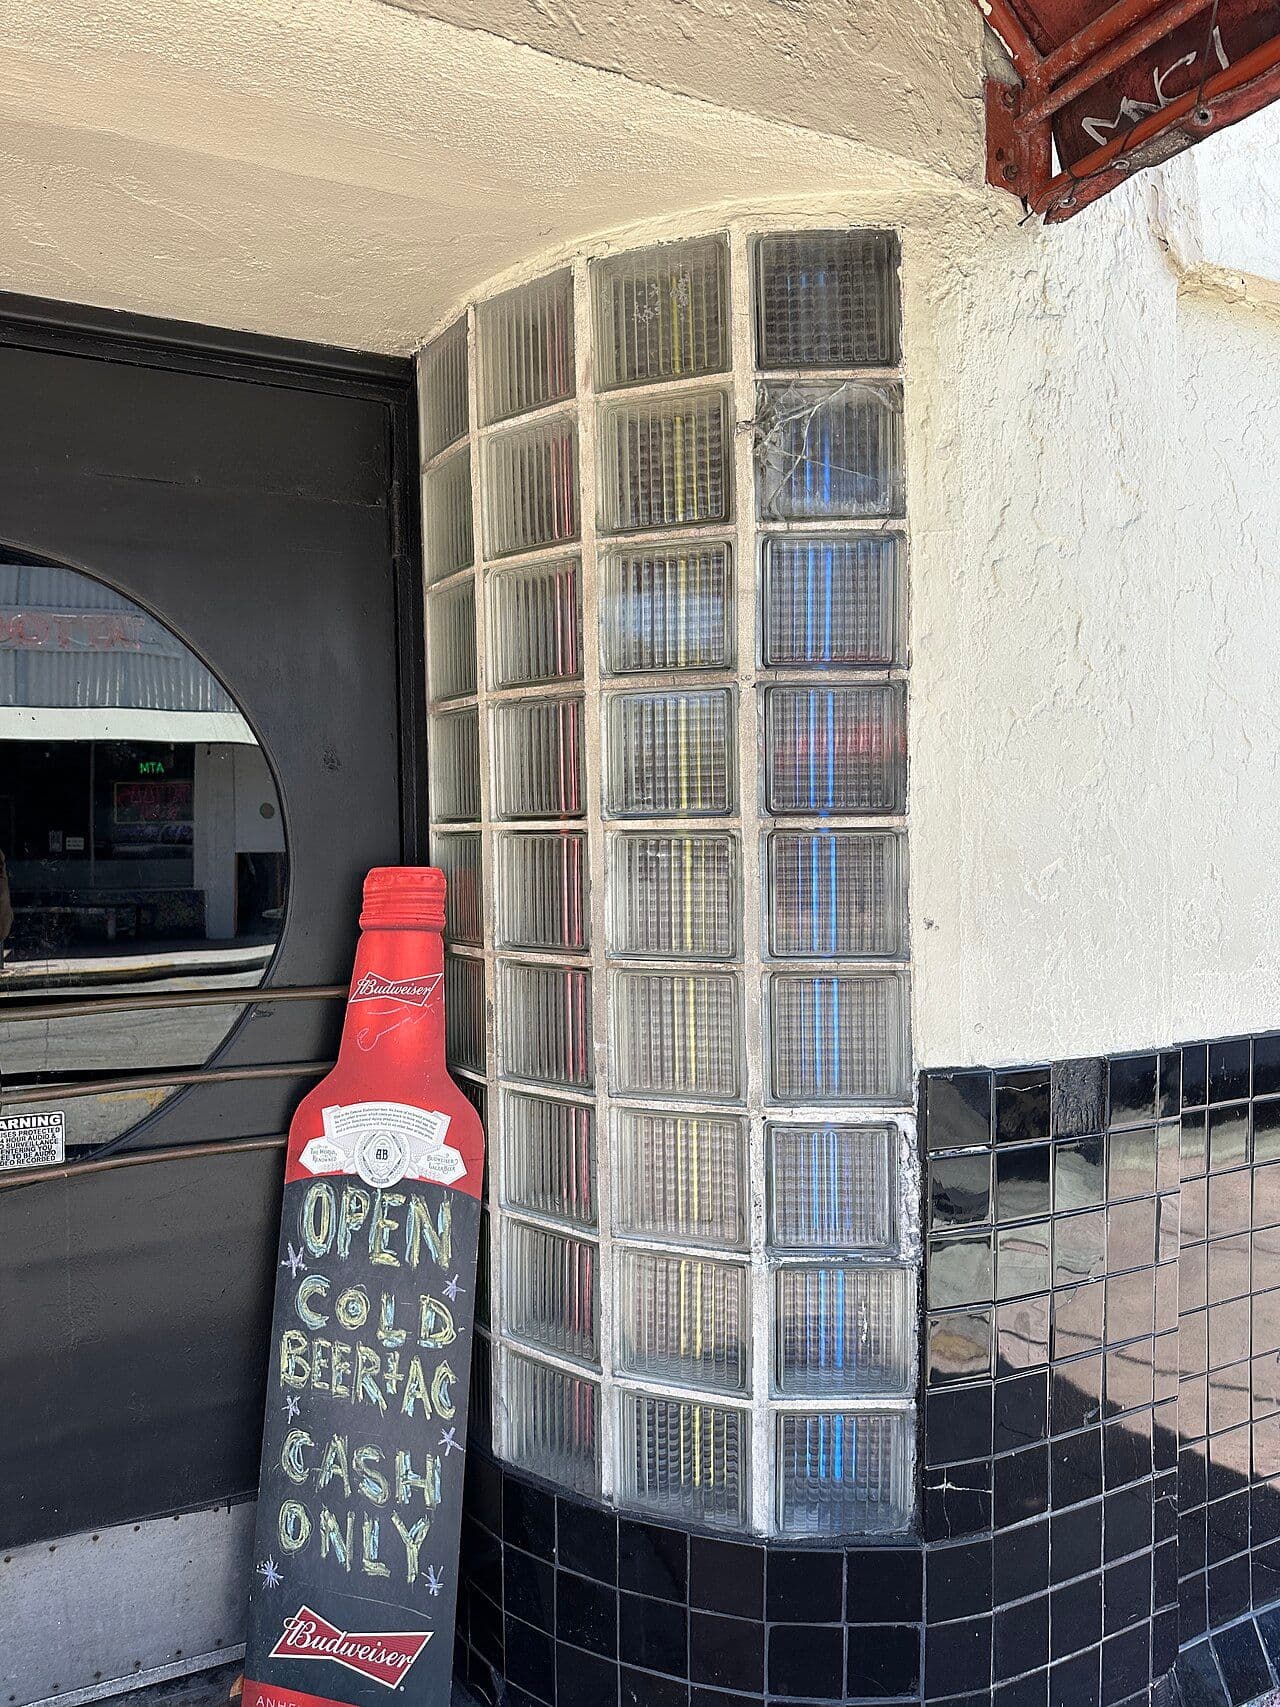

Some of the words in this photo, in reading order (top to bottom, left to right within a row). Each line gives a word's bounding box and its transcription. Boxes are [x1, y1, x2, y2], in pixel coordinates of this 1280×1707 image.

[357, 978, 432, 996] Budweiser
[18, 1126, 61, 1137] PROTECTED
[28, 1133, 50, 1141] AUDIO
[302, 1182, 454, 1271] OPEN
[294, 1274, 457, 1349] COLD
[281, 1428, 442, 1510] CASH
[278, 1498, 432, 1585] ONLY
[283, 1616, 416, 1669] Budweiser
